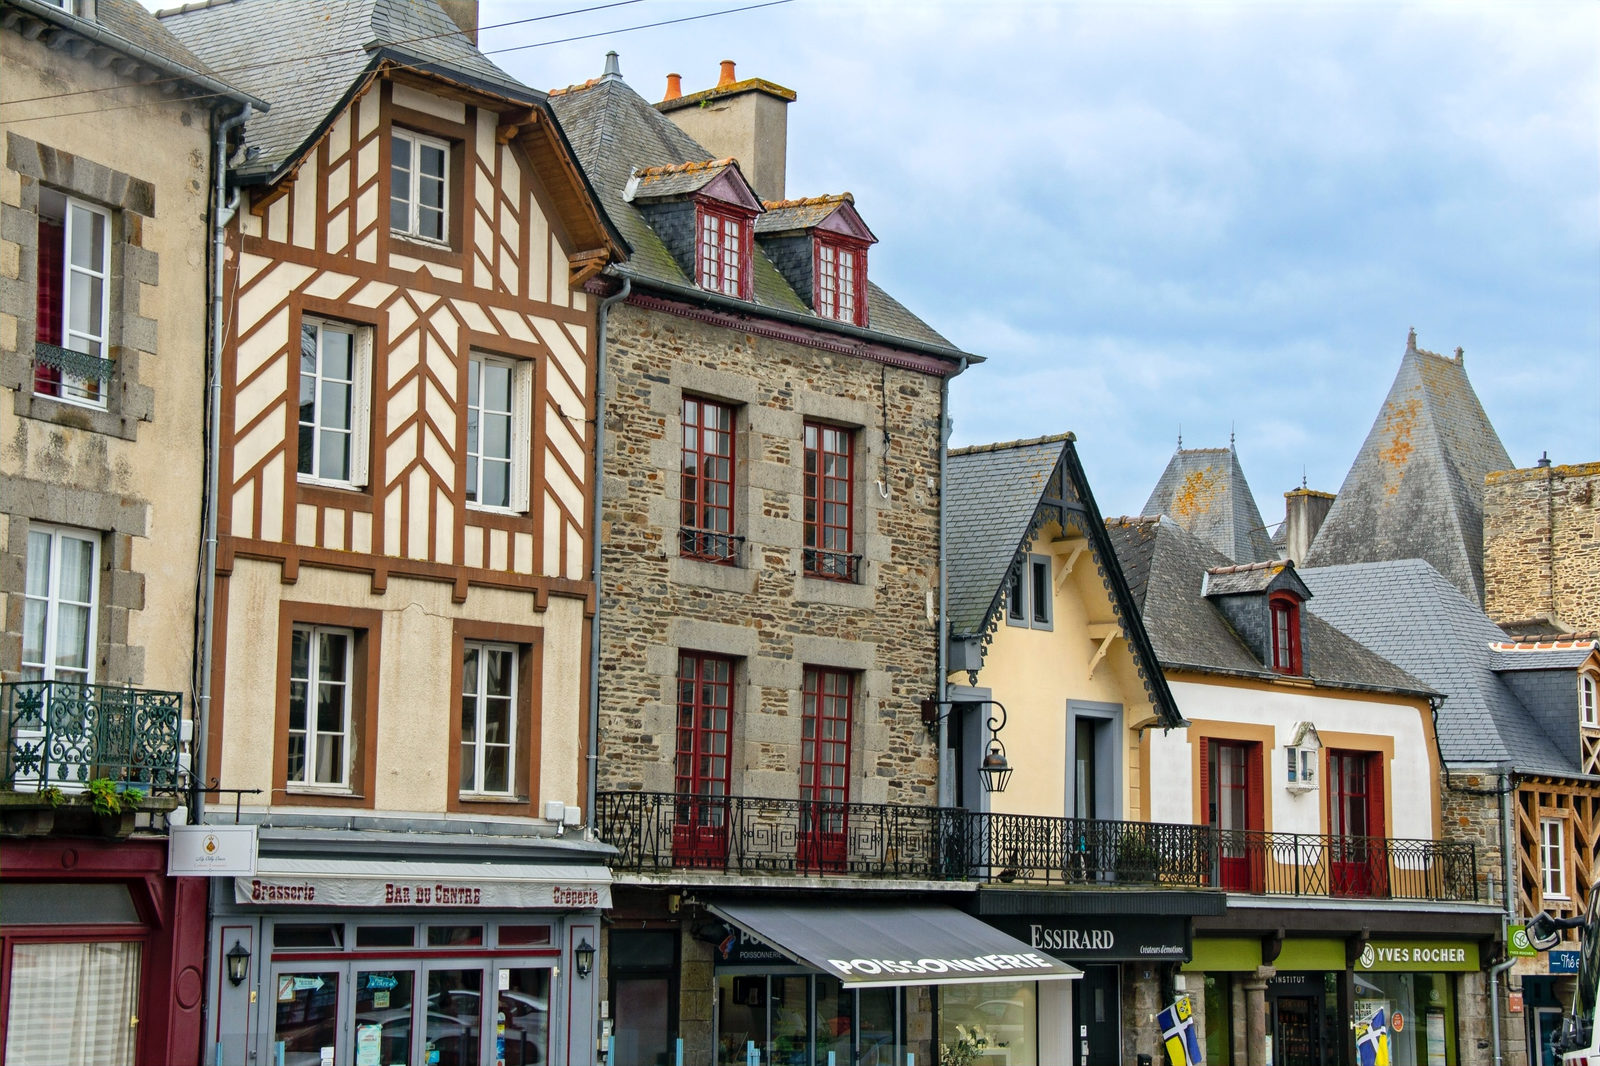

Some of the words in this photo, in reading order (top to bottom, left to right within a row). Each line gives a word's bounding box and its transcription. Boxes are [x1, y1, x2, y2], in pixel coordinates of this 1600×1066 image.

[252, 880, 315, 901] Brasserie
[385, 883, 410, 903] BAR
[415, 887, 432, 904] DU
[435, 884, 481, 905] CENTRE
[552, 885, 599, 907] Crêperie
[740, 951, 782, 959] POISSONNERIE
[828, 953, 1053, 975] POISSONNERIE
[1377, 947, 1410, 962] YVES
[1412, 948, 1466, 962] ROCHER
